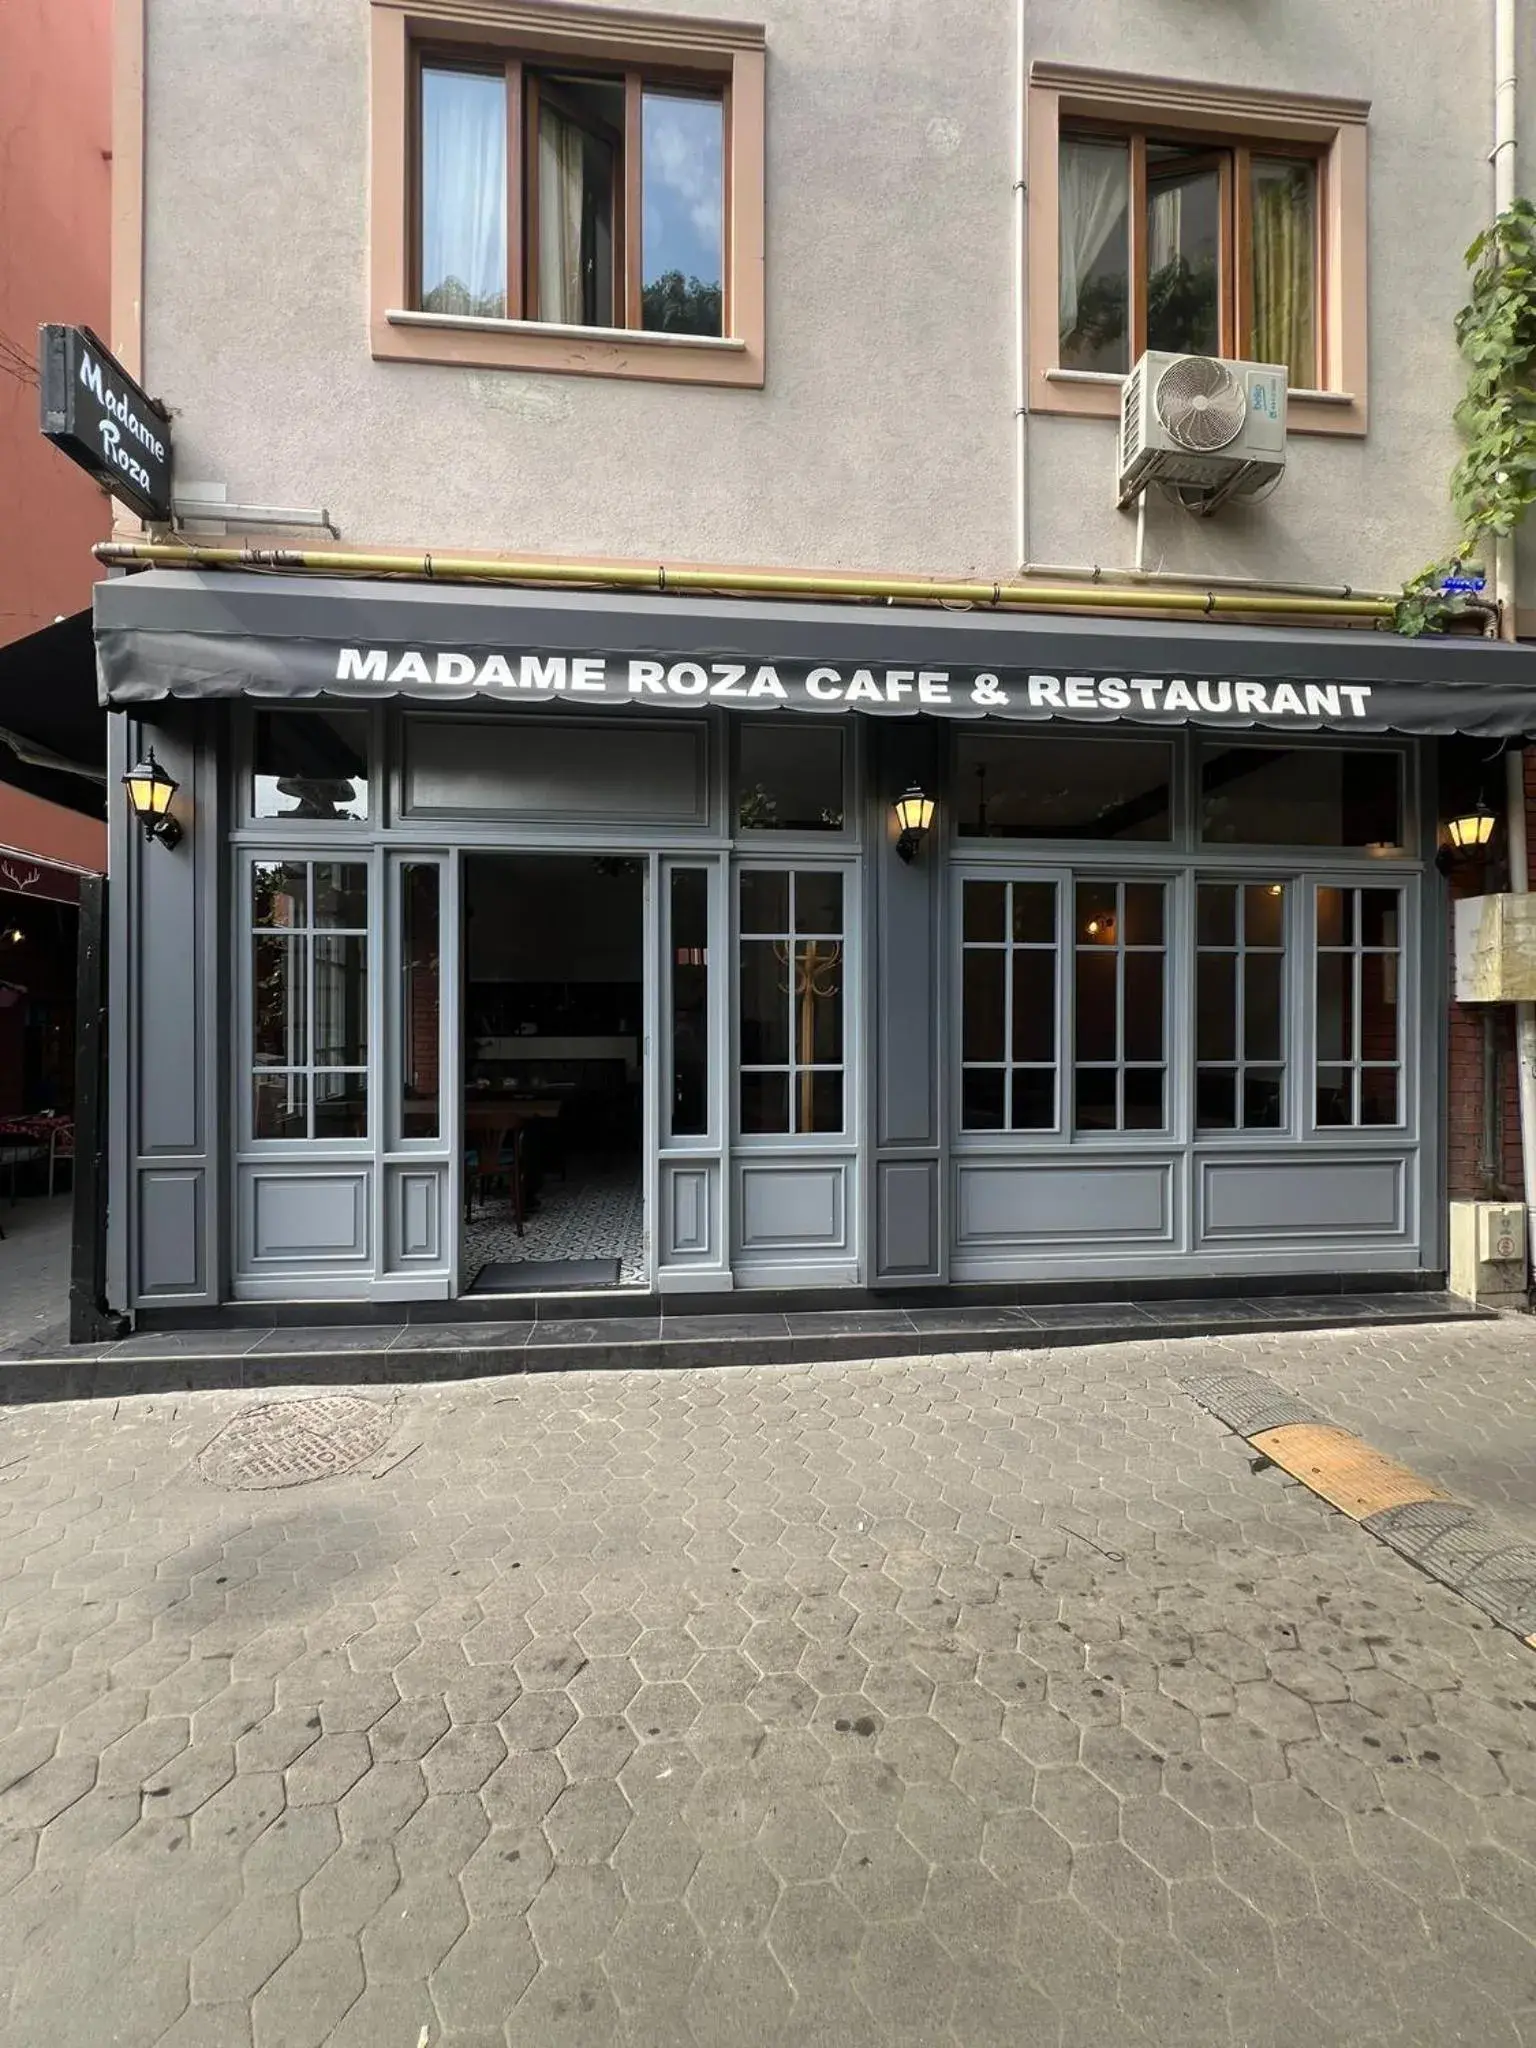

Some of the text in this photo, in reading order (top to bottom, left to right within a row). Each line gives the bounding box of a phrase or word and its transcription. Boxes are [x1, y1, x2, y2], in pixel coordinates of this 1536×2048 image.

[80, 350, 165, 464] Madame
[99, 419, 151, 494] Roza
[336, 649, 1371, 717] MADAME ROZA CAFE & RESTAURANT
